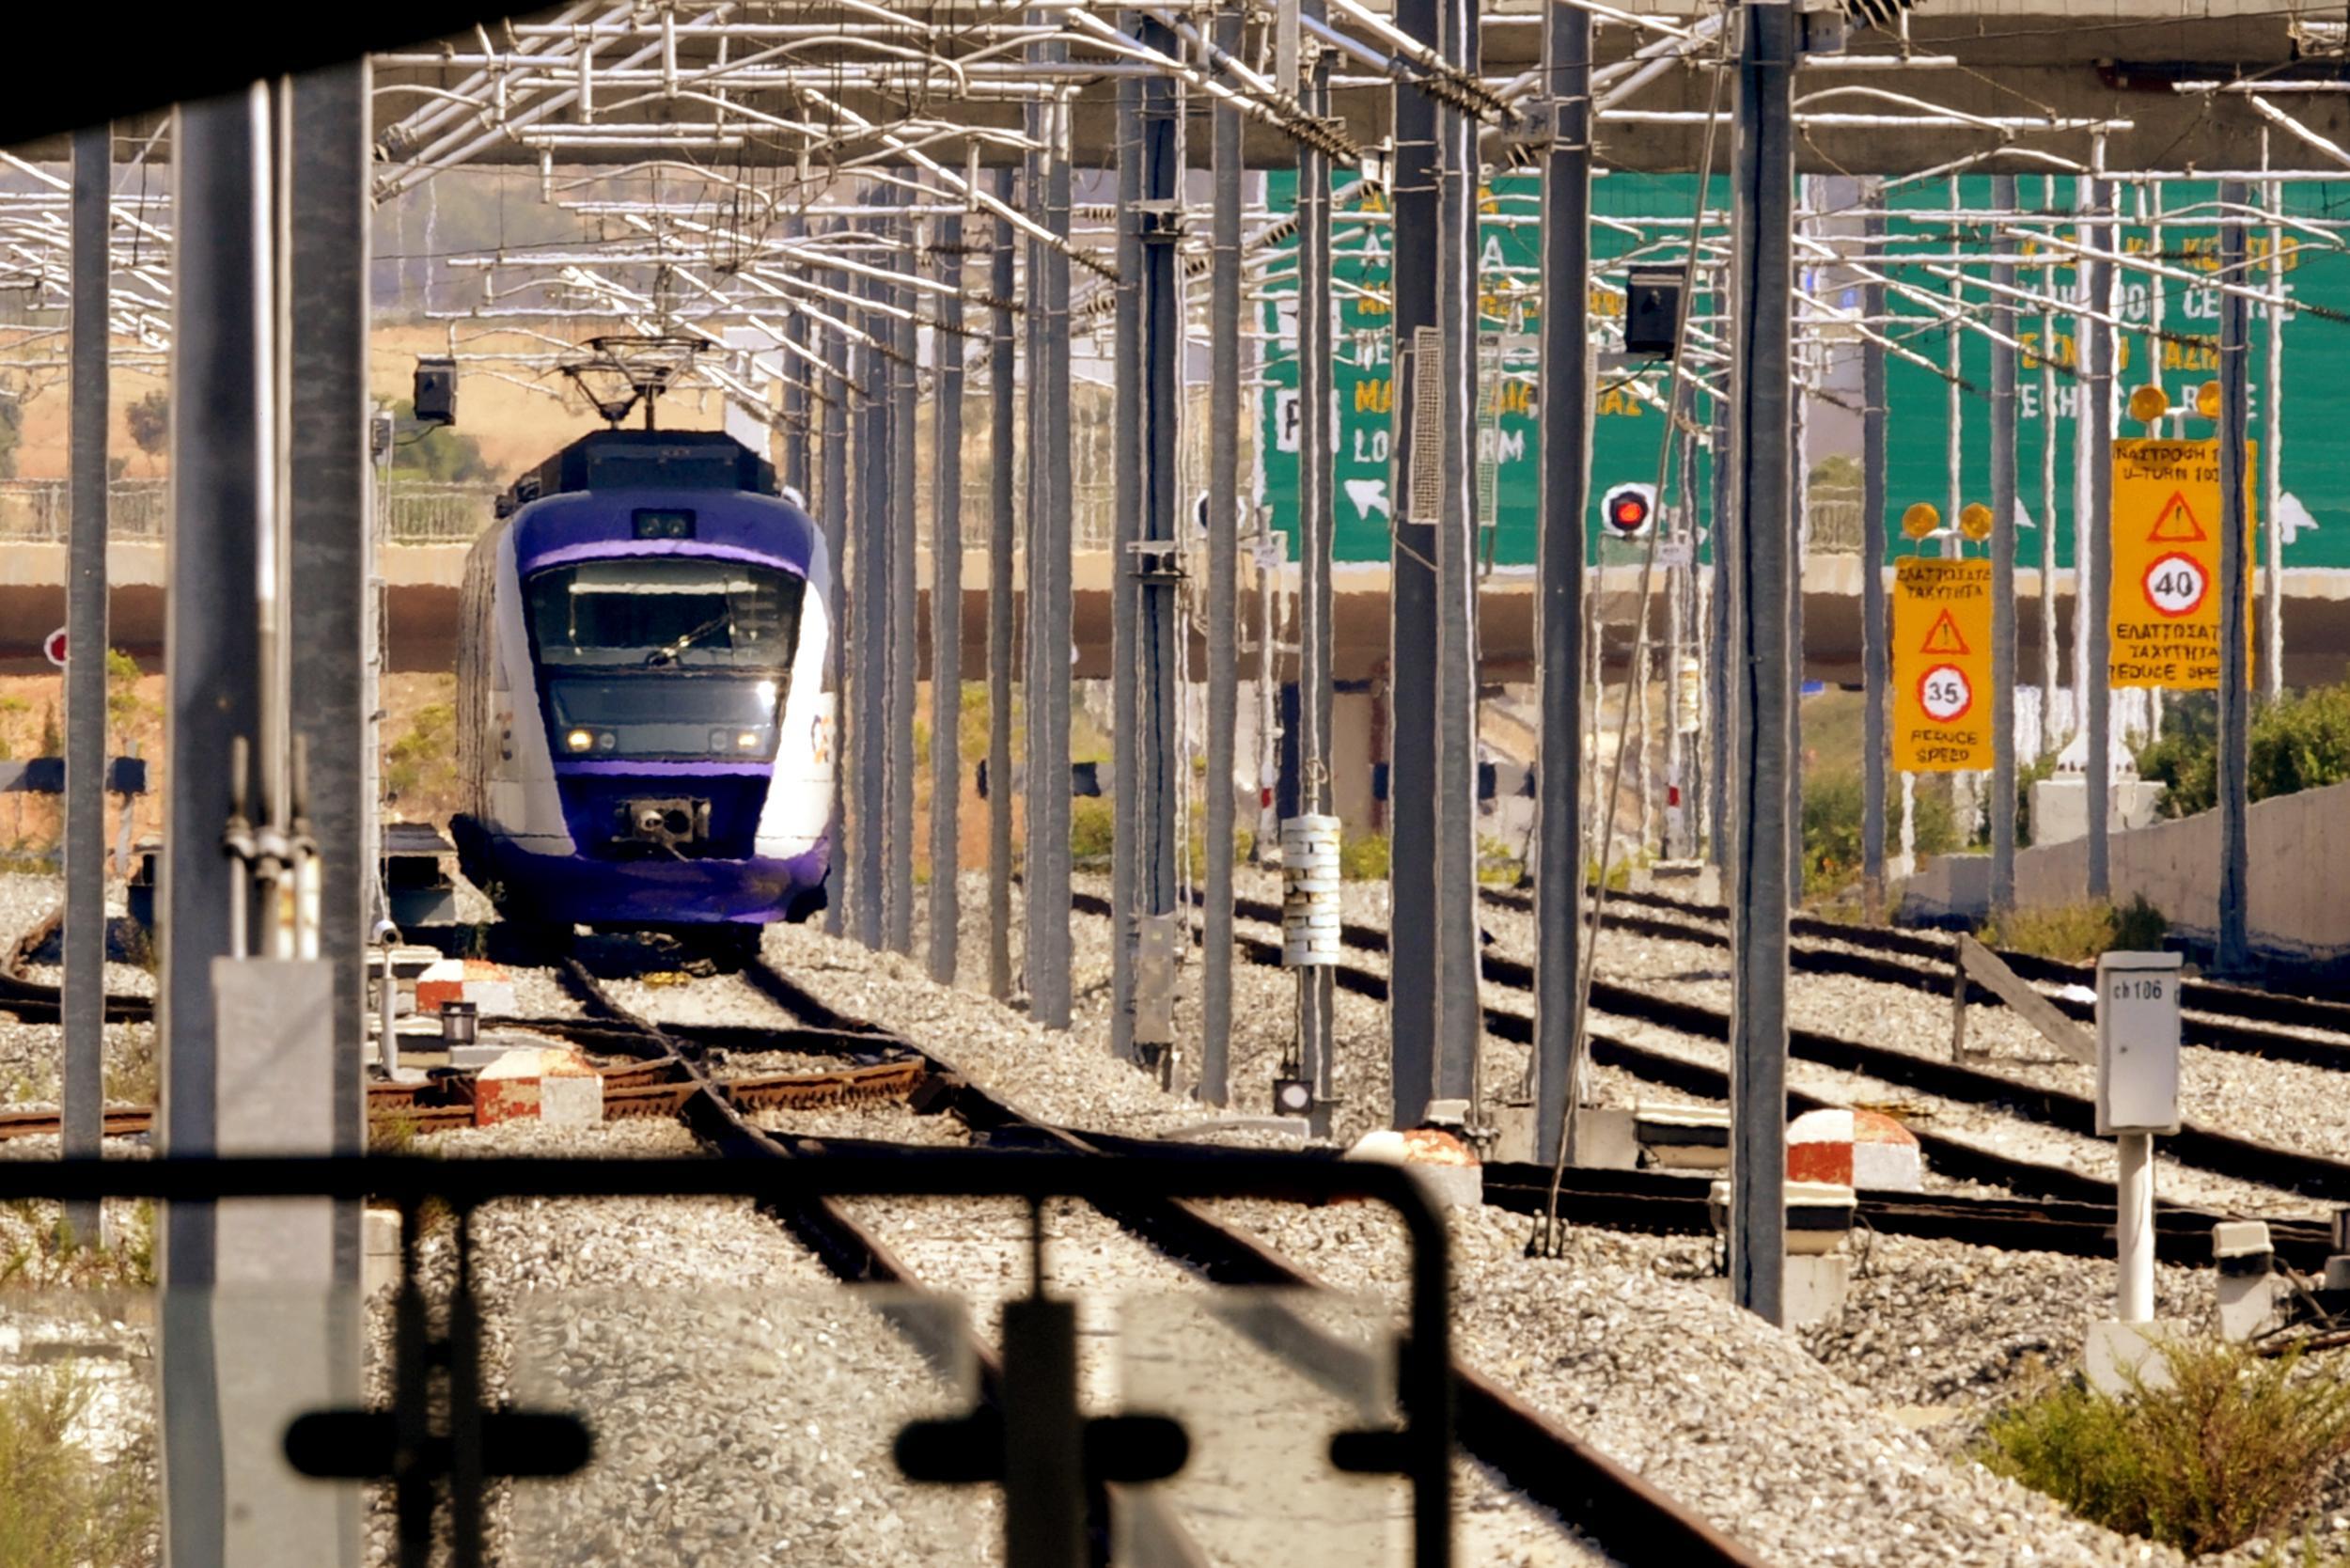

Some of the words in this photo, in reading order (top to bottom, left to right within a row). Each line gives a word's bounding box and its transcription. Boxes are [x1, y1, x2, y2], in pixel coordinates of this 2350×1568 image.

[2154, 571, 2194, 597] 40
[1929, 681, 1959, 705] 35
[1910, 729, 1978, 745] REDUCE
[1916, 747, 1969, 763] SPEED
